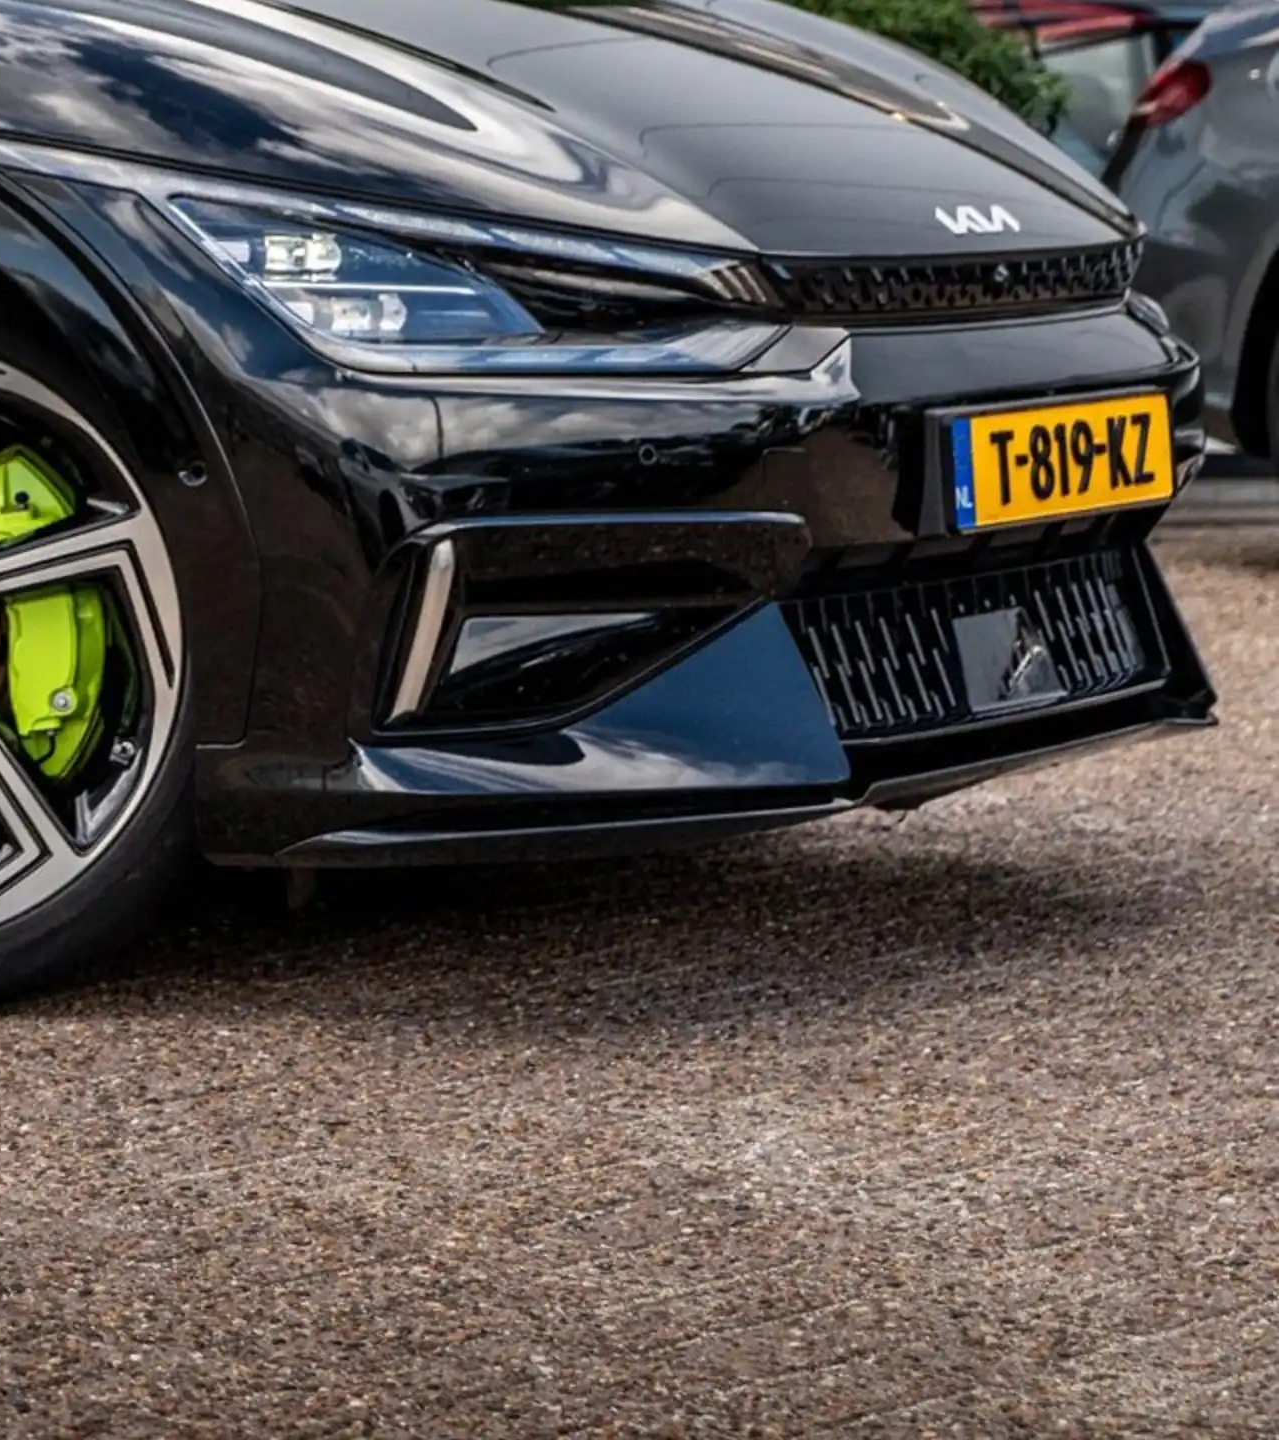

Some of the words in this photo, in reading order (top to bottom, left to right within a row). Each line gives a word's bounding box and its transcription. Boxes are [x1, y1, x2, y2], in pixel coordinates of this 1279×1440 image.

[935, 205, 1021, 235] KIA
[990, 412, 1155, 506] T-819-KZ
[955, 485, 974, 510] NL
